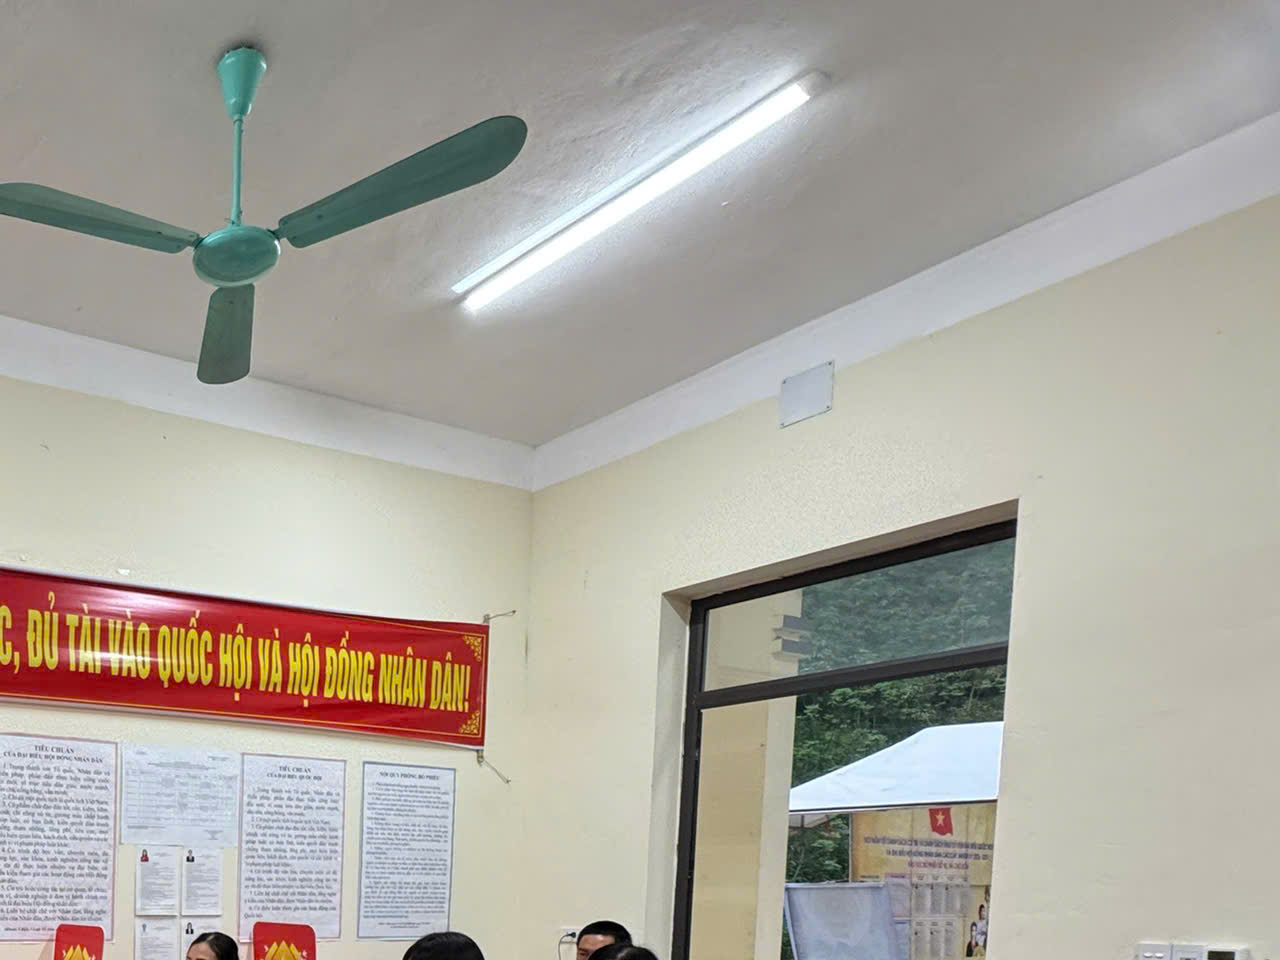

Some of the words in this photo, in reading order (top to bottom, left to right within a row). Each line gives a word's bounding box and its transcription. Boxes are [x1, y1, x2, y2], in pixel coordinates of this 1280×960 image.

[26, 591, 59, 670] ĐỦ
[66, 603, 101, 674] TÀI
[109, 609, 151, 680] VÀO
[157, 611, 213, 689] QUỐC
[219, 624, 252, 701] HỘI
[258, 627, 282, 693] VÀ
[287, 632, 319, 707] HỘI
[325, 631, 373, 702] ĐỒNG
[378, 646, 426, 710] NHÂN
[429, 652, 471, 713] DÂN!
